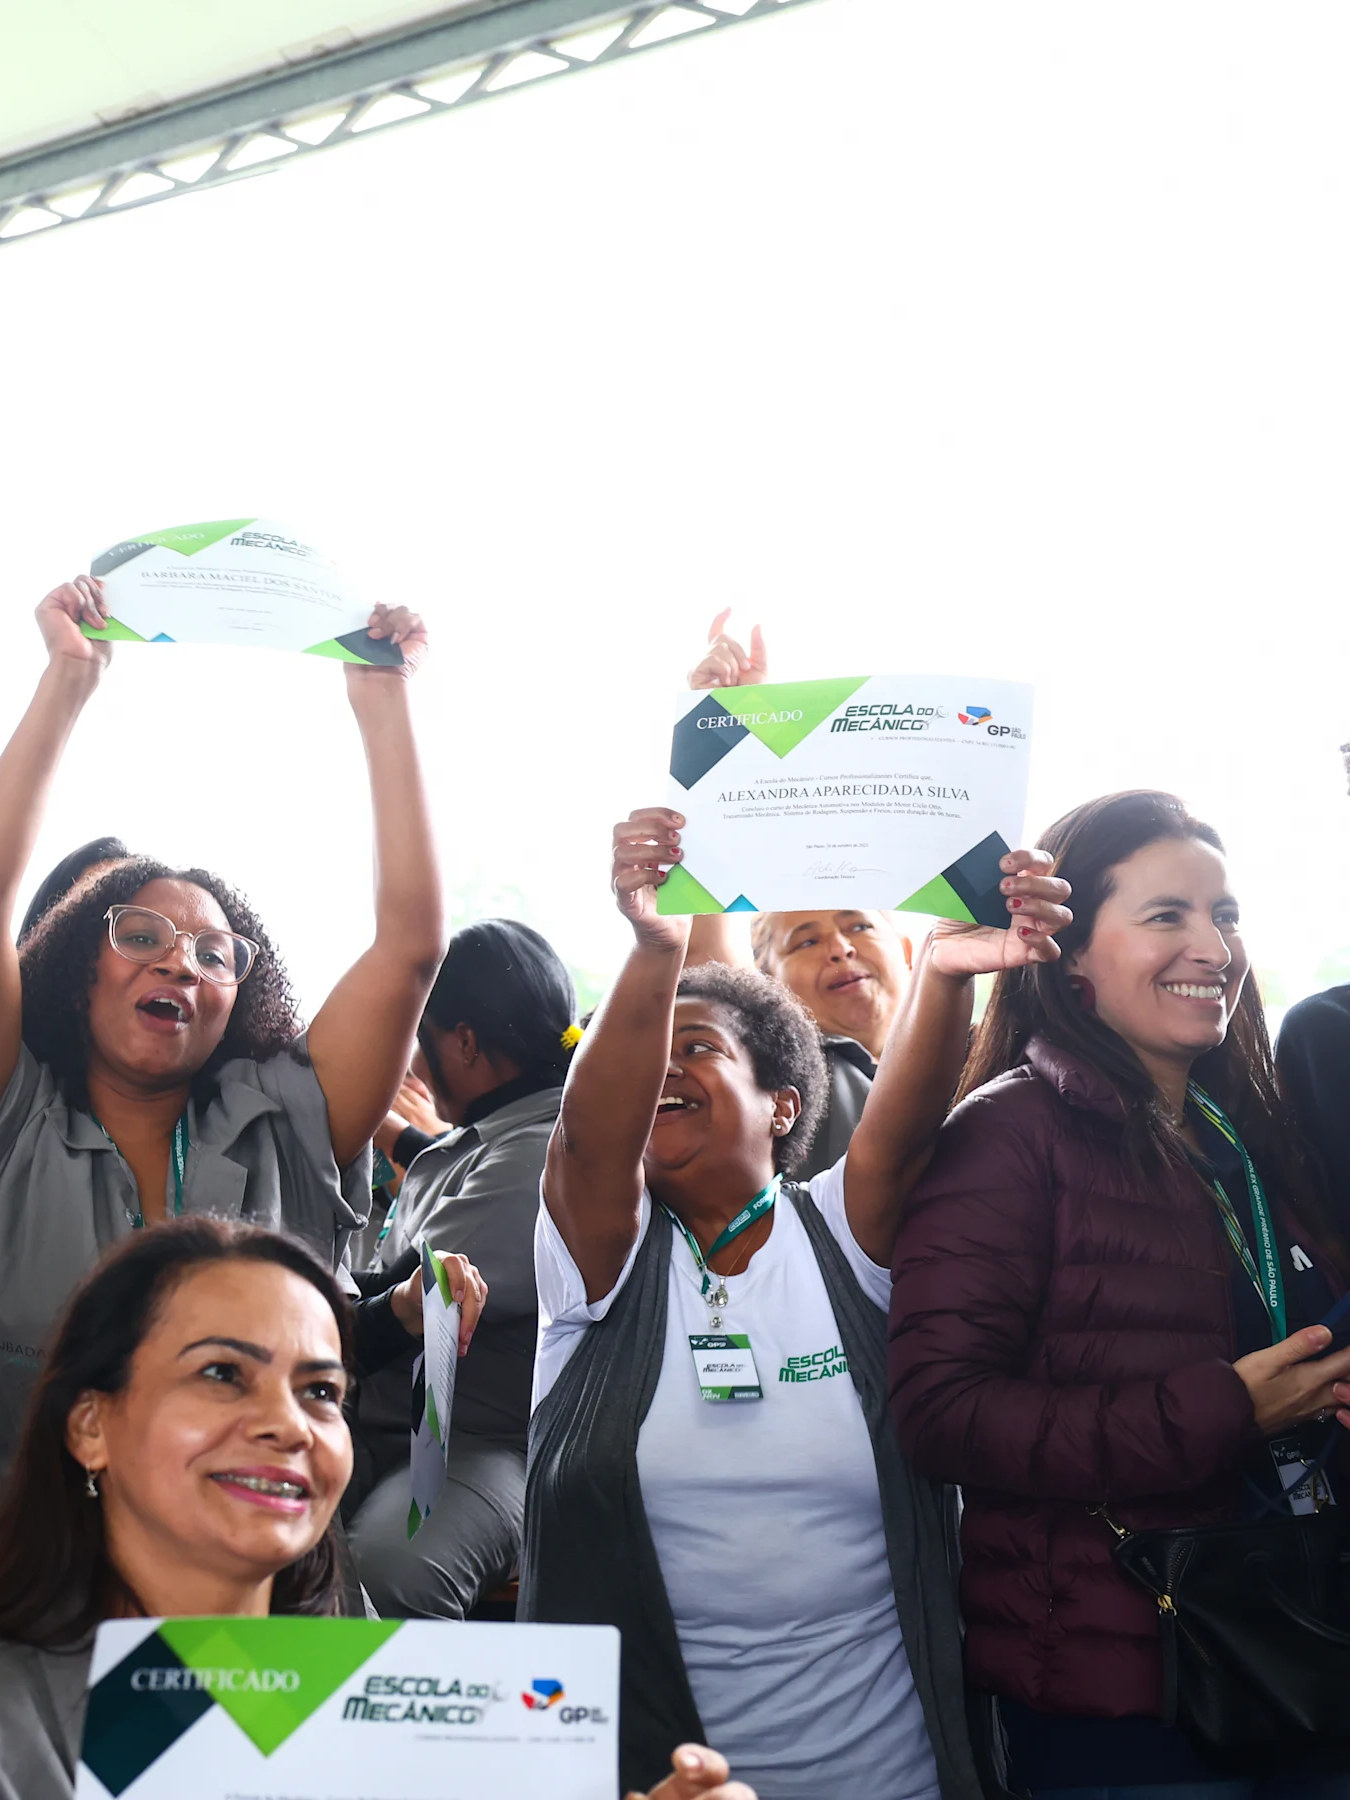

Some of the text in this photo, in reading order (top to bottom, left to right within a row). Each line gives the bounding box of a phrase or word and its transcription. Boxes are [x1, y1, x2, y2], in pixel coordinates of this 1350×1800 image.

[241, 531, 298, 546] ESCOLA
[209, 573, 261, 583] MACIEL
[264, 577, 291, 587] DOS
[696, 709, 803, 730] CERTIFICADO
[845, 704, 934, 717] ESCOLA DO
[830, 717, 924, 733] MECÂNICO
[986, 724, 1011, 737] GP
[717, 784, 970, 803] ALEXANDRA APARECIDADA SILVA
[1252, 1184, 1265, 1216] GRANDE
[1260, 1216, 1271, 1248] PRÊMIO
[1264, 1249, 1273, 1260] DE
[1266, 1260, 1276, 1279] SÃO
[1268, 1279, 1278, 1308] PAULO
[787, 1345, 846, 1369] ESCOL
[779, 1360, 847, 1383] MECÂNI
[130, 1667, 301, 1693] CERTIFICADO
[364, 1675, 490, 1698] ESCOLA DO
[342, 1696, 477, 1724] MECÂNICO
[559, 1706, 589, 1725] GP
